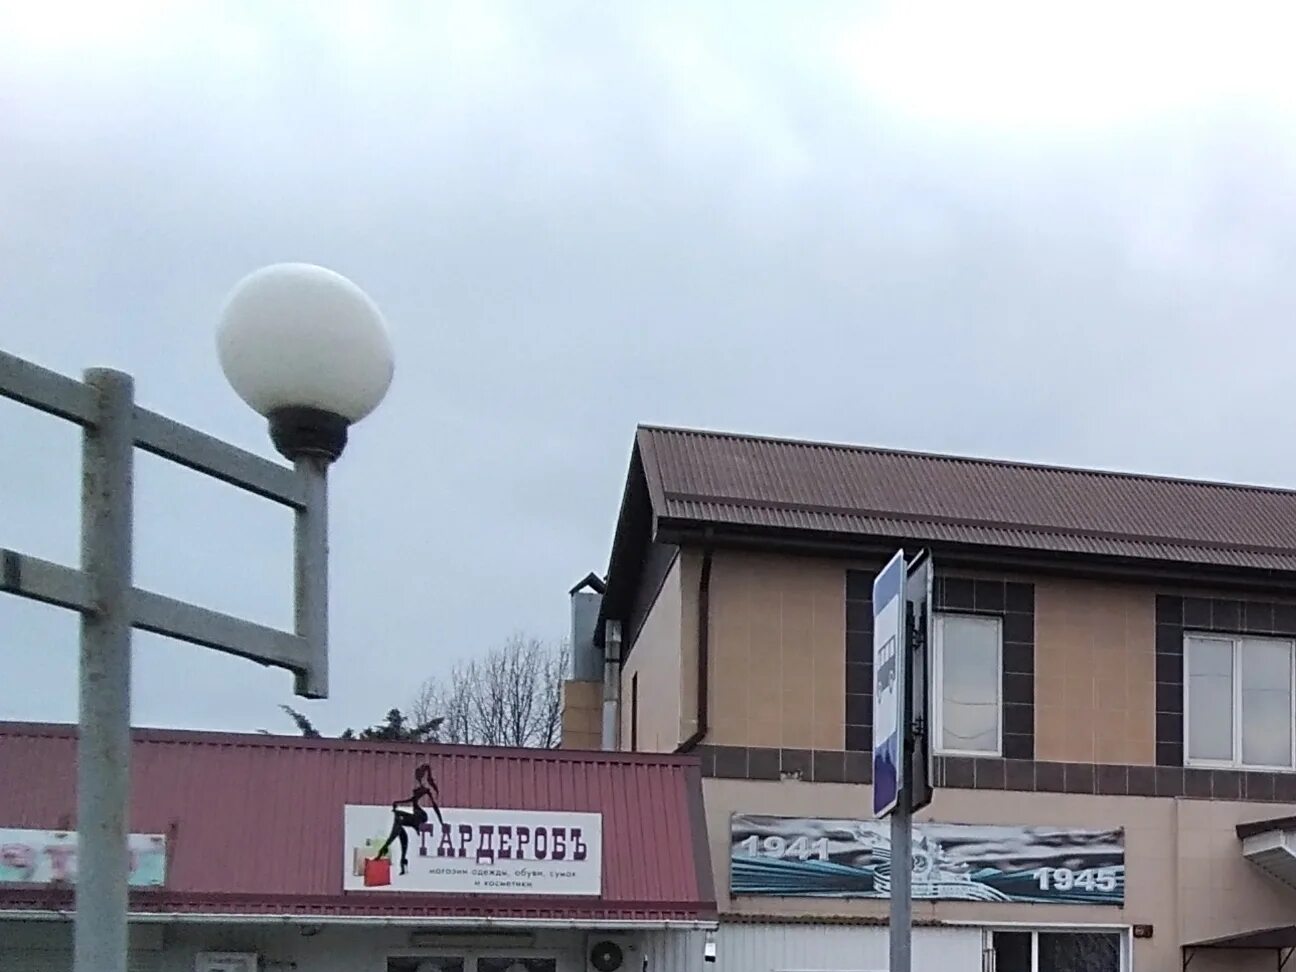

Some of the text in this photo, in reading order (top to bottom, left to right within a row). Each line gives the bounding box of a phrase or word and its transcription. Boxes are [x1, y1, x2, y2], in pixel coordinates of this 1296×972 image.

[418, 822, 588, 865] ГАРДЕРОБЪ
[740, 834, 830, 862] 1941
[428, 867, 468, 875] магазин
[483, 880, 533, 888] косметики
[1032, 866, 1117, 892] 1945
